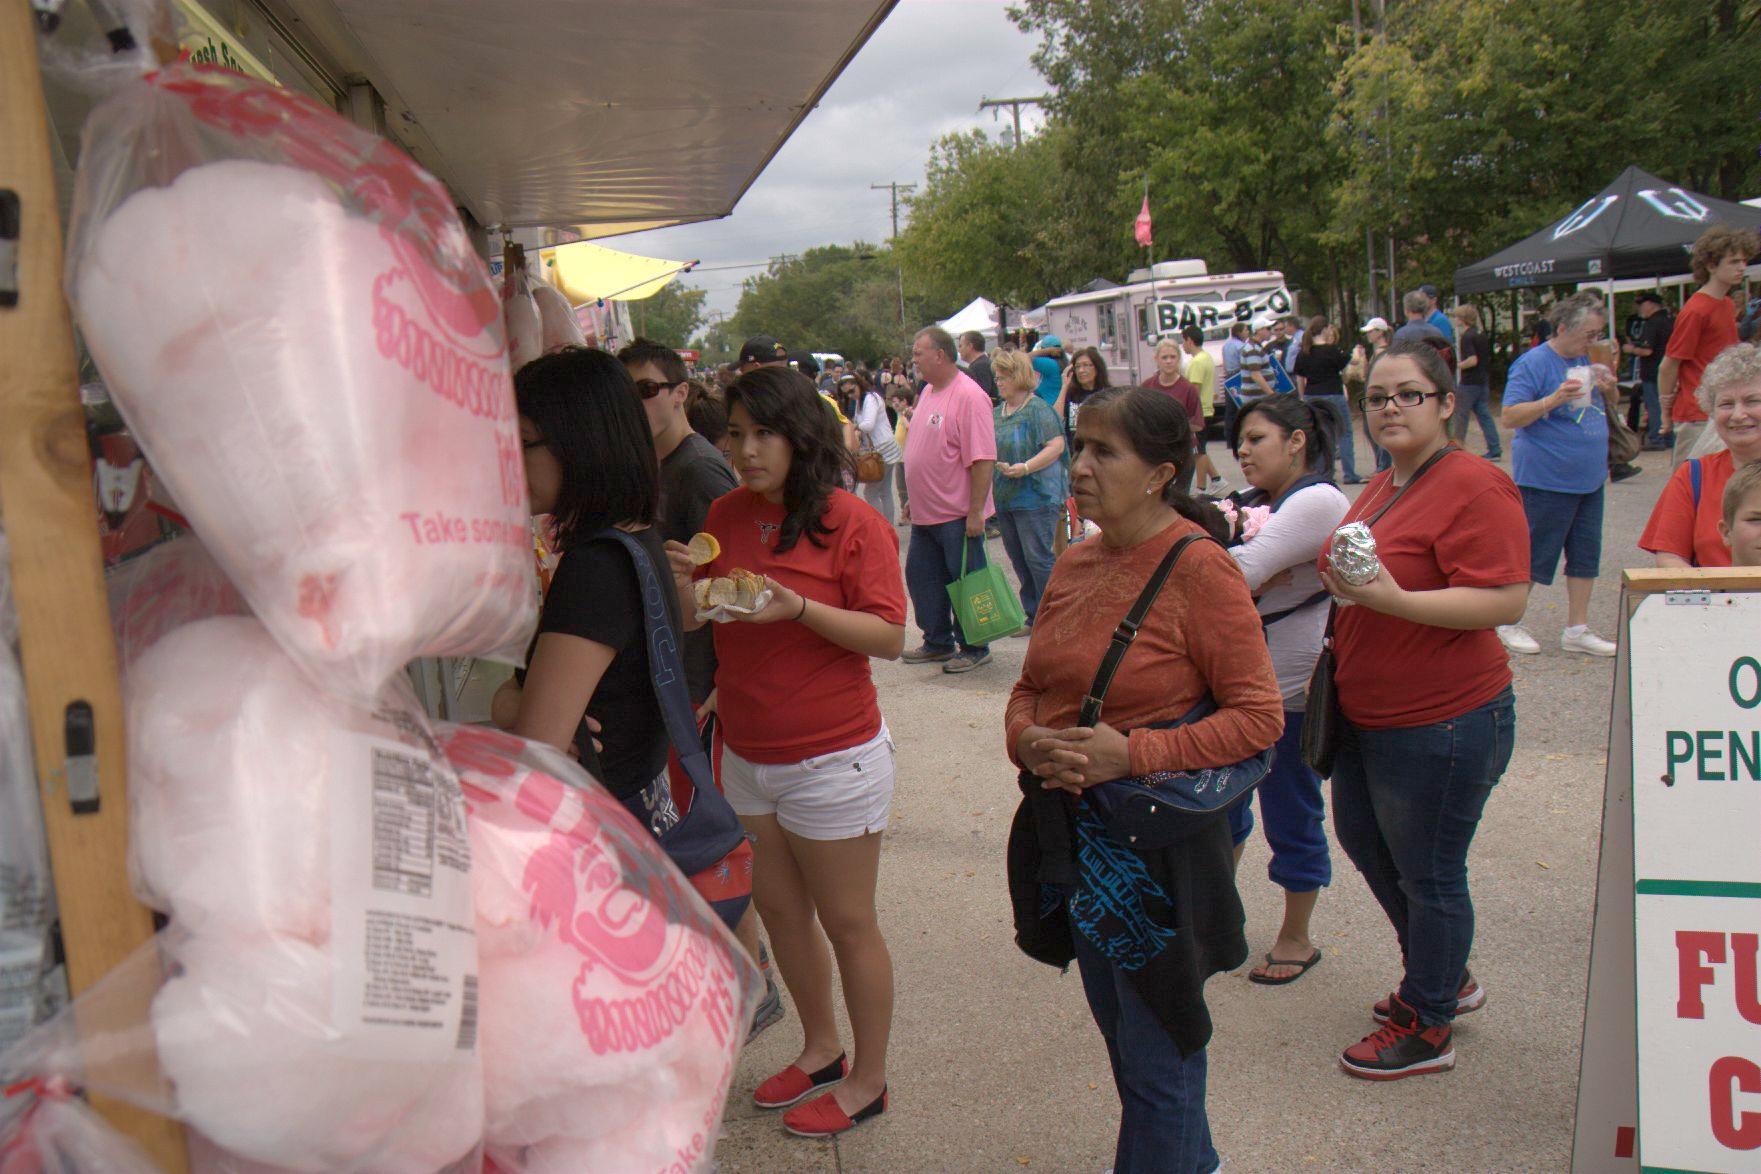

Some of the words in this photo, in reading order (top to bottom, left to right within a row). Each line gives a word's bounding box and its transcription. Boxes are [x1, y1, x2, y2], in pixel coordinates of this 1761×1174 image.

[1156, 289, 1291, 332] BAR-B-Q
[399, 511, 467, 546] Take
[1666, 730, 1761, 785] PEN
